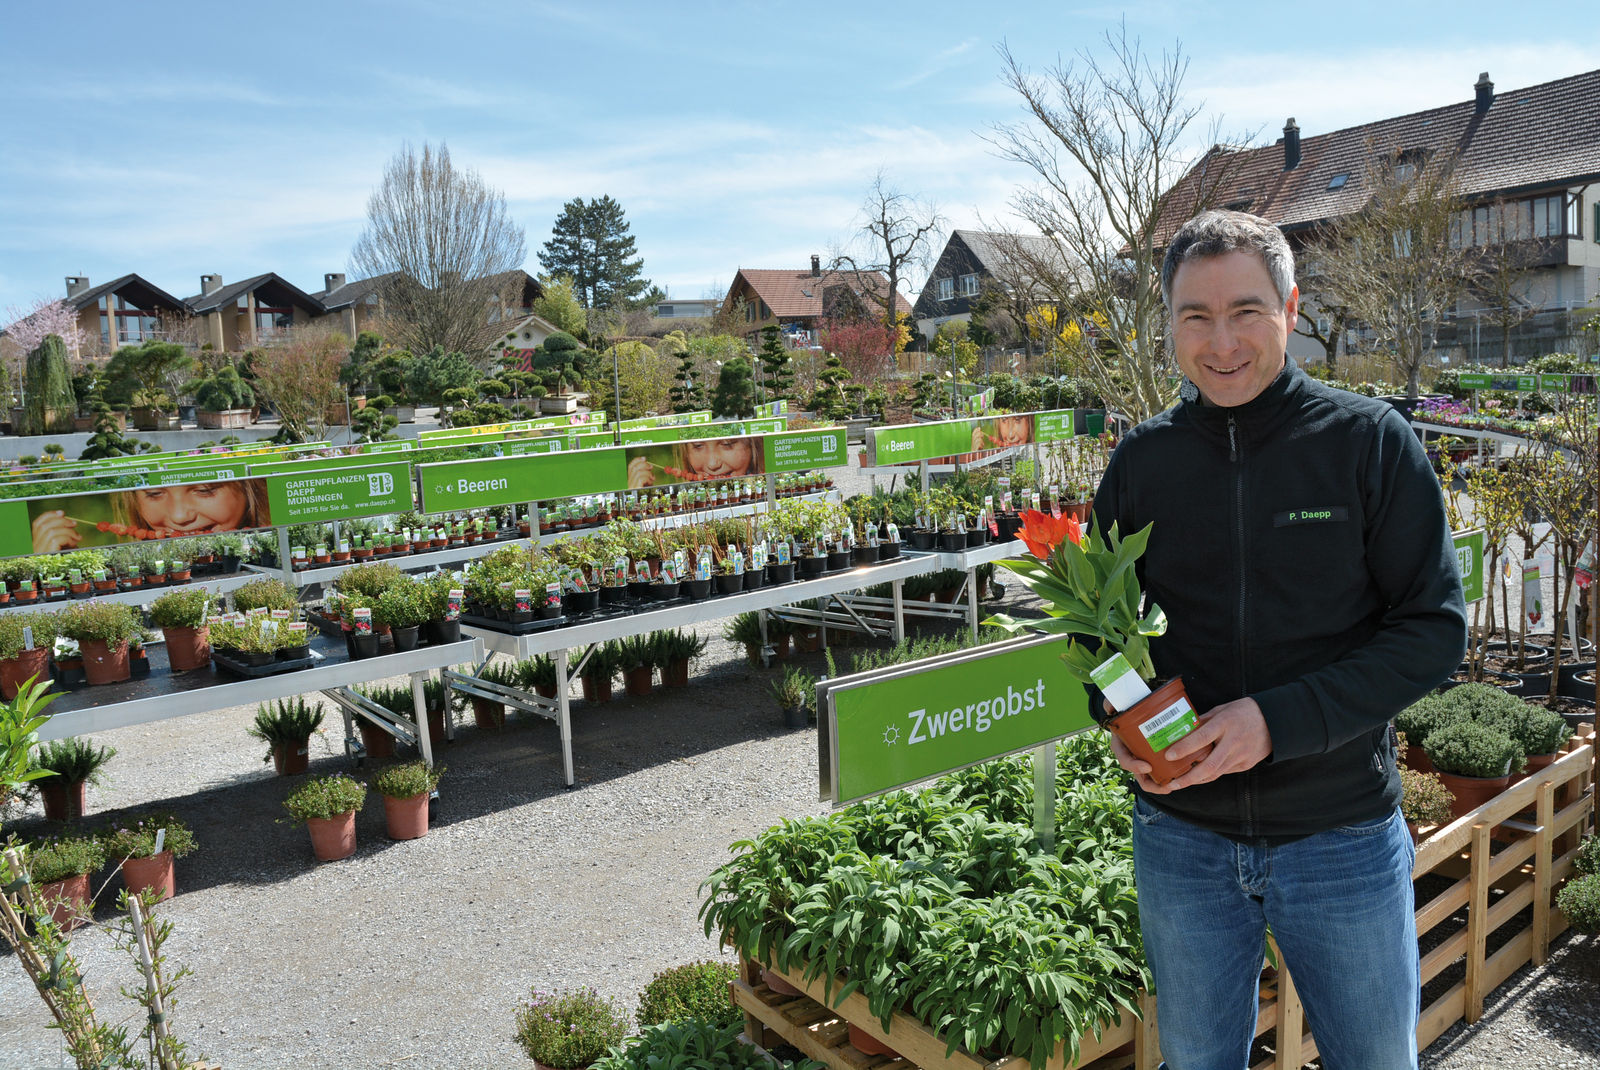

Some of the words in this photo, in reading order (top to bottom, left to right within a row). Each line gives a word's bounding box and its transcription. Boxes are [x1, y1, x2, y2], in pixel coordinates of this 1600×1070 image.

[890, 439, 915, 452] Beeren
[160, 470, 216, 481] GARTENPFLANZEN
[285, 474, 366, 490] GARTENPFLANZEN
[286, 487, 316, 498] DAEPP
[457, 477, 508, 494] Beeren
[288, 508, 301, 516] Seit
[303, 506, 319, 514] 1875
[330, 503, 340, 511] Sie
[354, 498, 396, 509] www.daepp.ch
[1289, 512, 1297, 520] P.
[1301, 510, 1332, 520] Daepp
[907, 678, 1046, 746] Zwergobst
